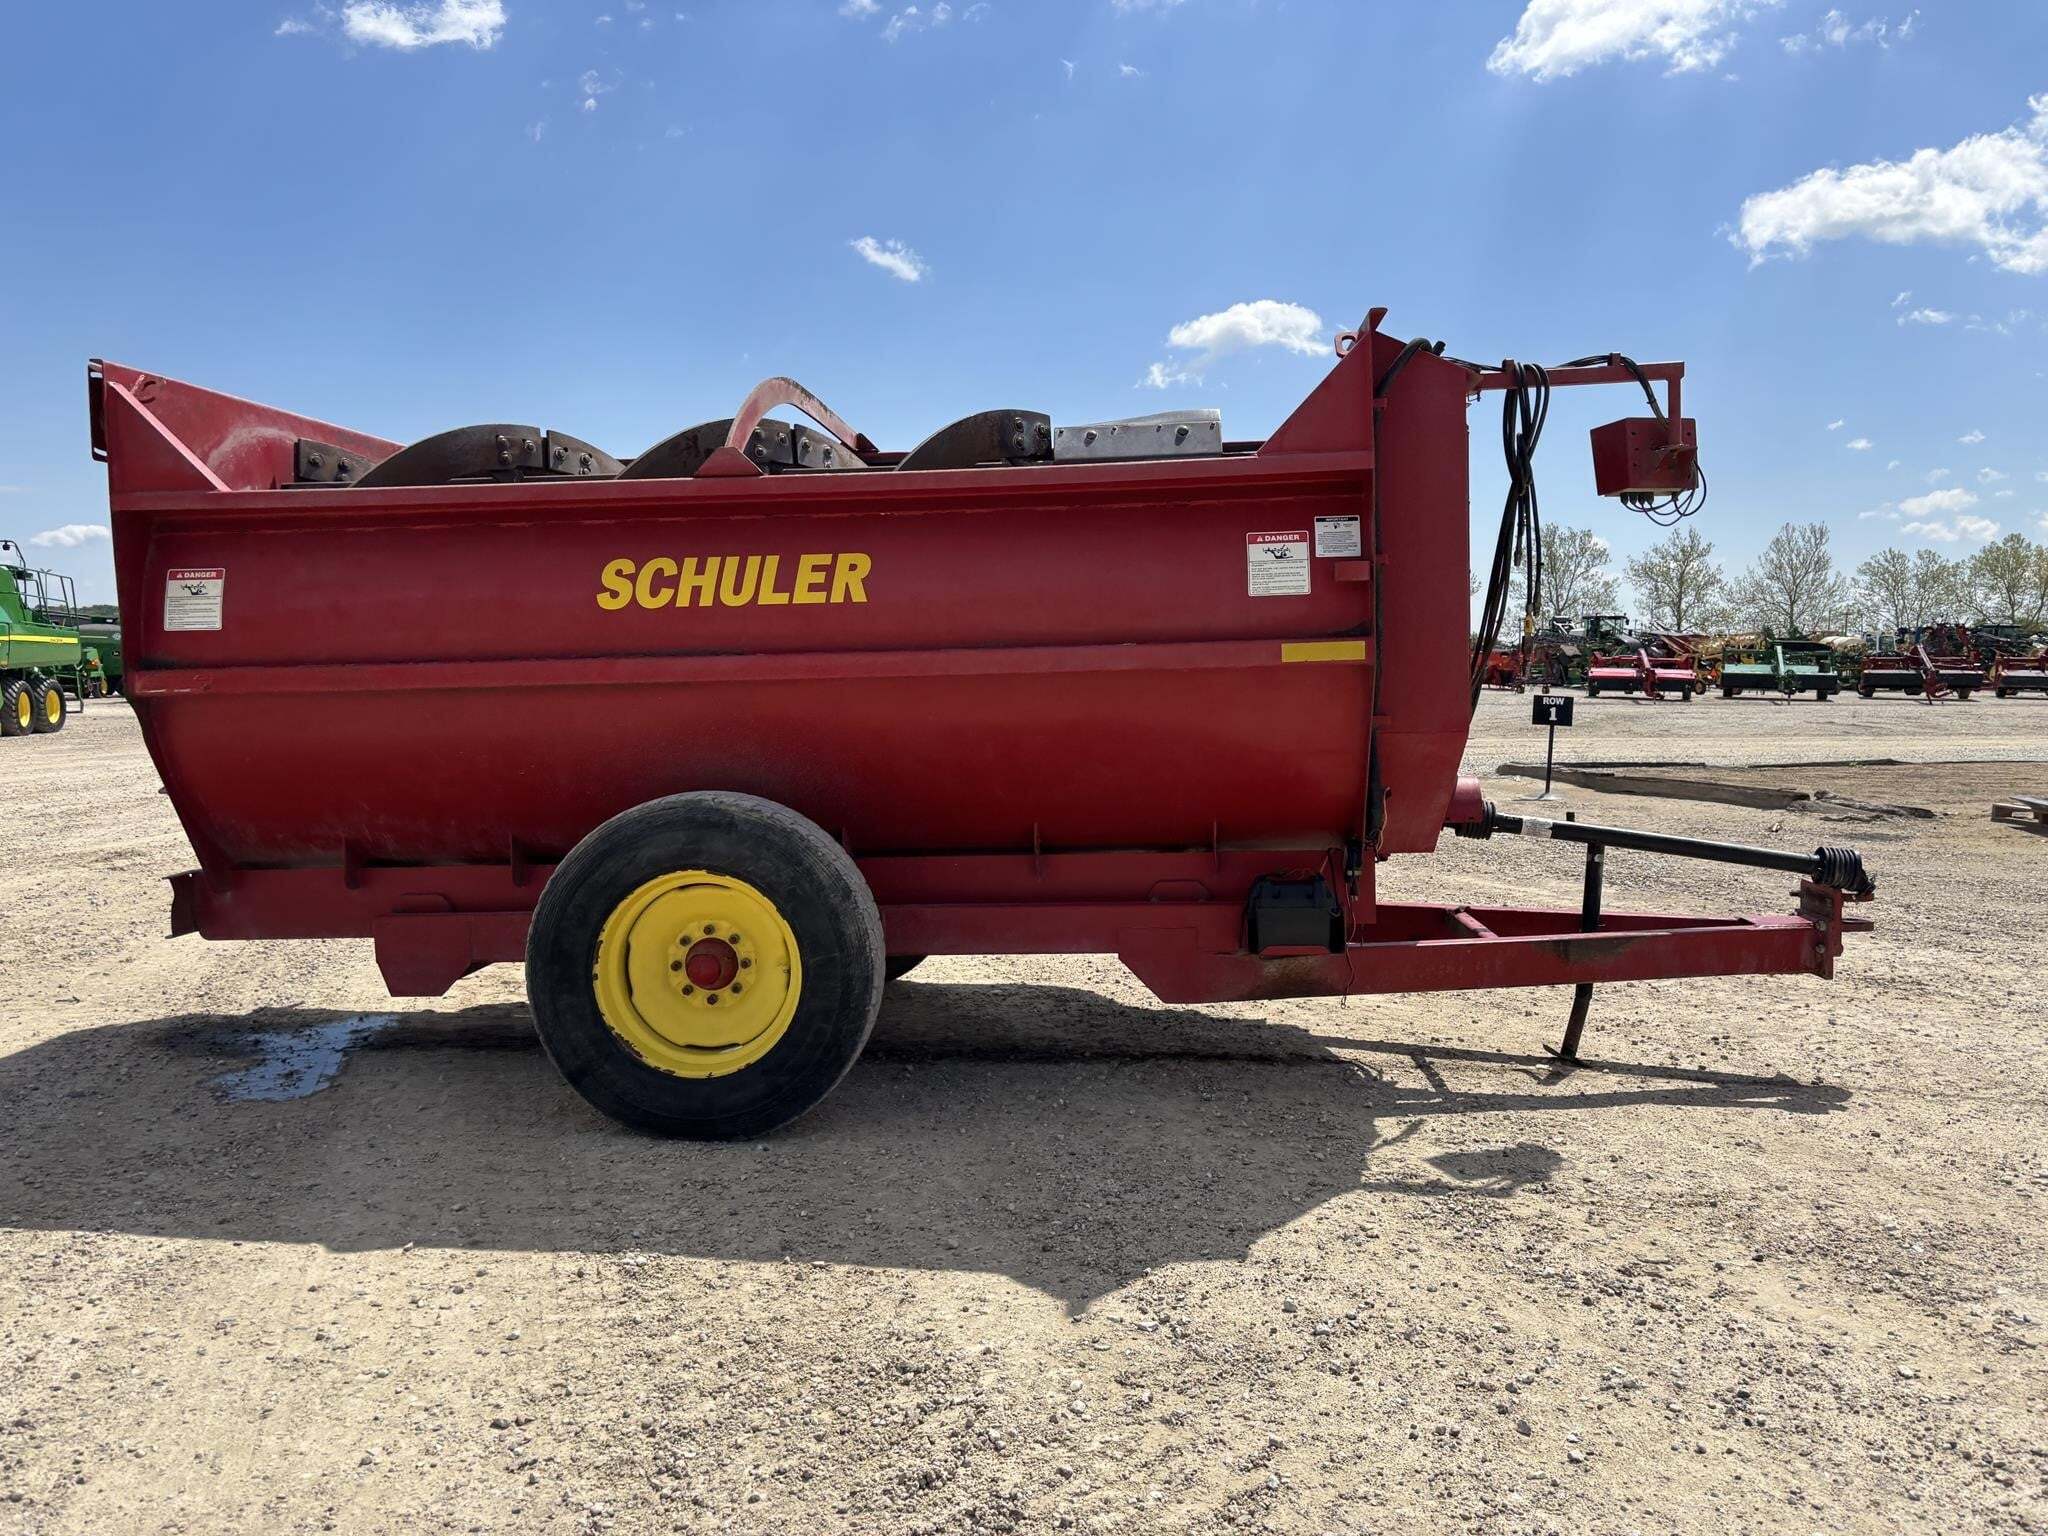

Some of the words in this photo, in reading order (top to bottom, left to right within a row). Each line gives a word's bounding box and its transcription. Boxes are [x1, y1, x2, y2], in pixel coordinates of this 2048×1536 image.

[1265, 534, 1300, 542] DANGER
[597, 552, 872, 610] SCHULER
[1543, 697, 1565, 705] ROW
[1549, 707, 1557, 721] 1
